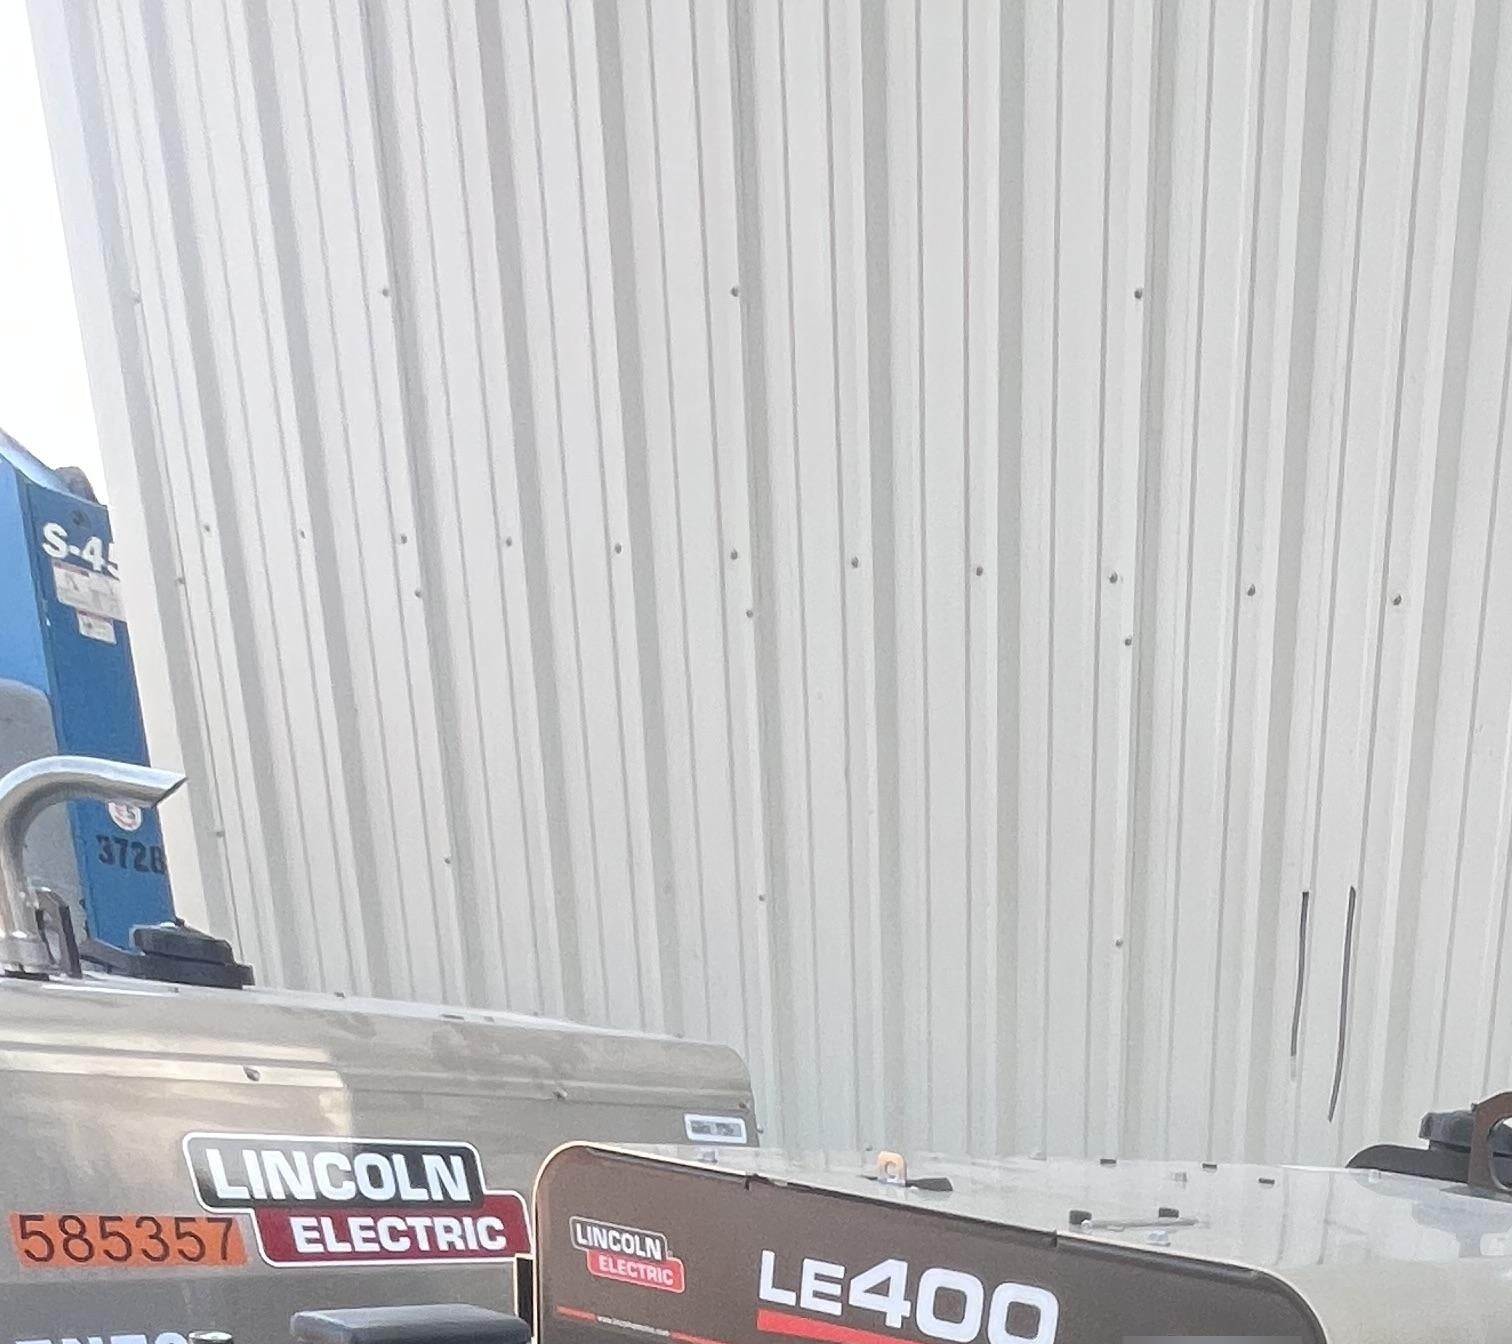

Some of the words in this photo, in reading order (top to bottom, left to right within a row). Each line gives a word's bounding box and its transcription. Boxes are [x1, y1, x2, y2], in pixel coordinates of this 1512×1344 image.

[205, 1147, 472, 1202] LINCOLN
[19, 1214, 234, 1264] 585357
[289, 1215, 507, 1254] ELECTRIC
[576, 1223, 662, 1261] LINCOLN
[600, 1255, 674, 1286] ELECTRIC
